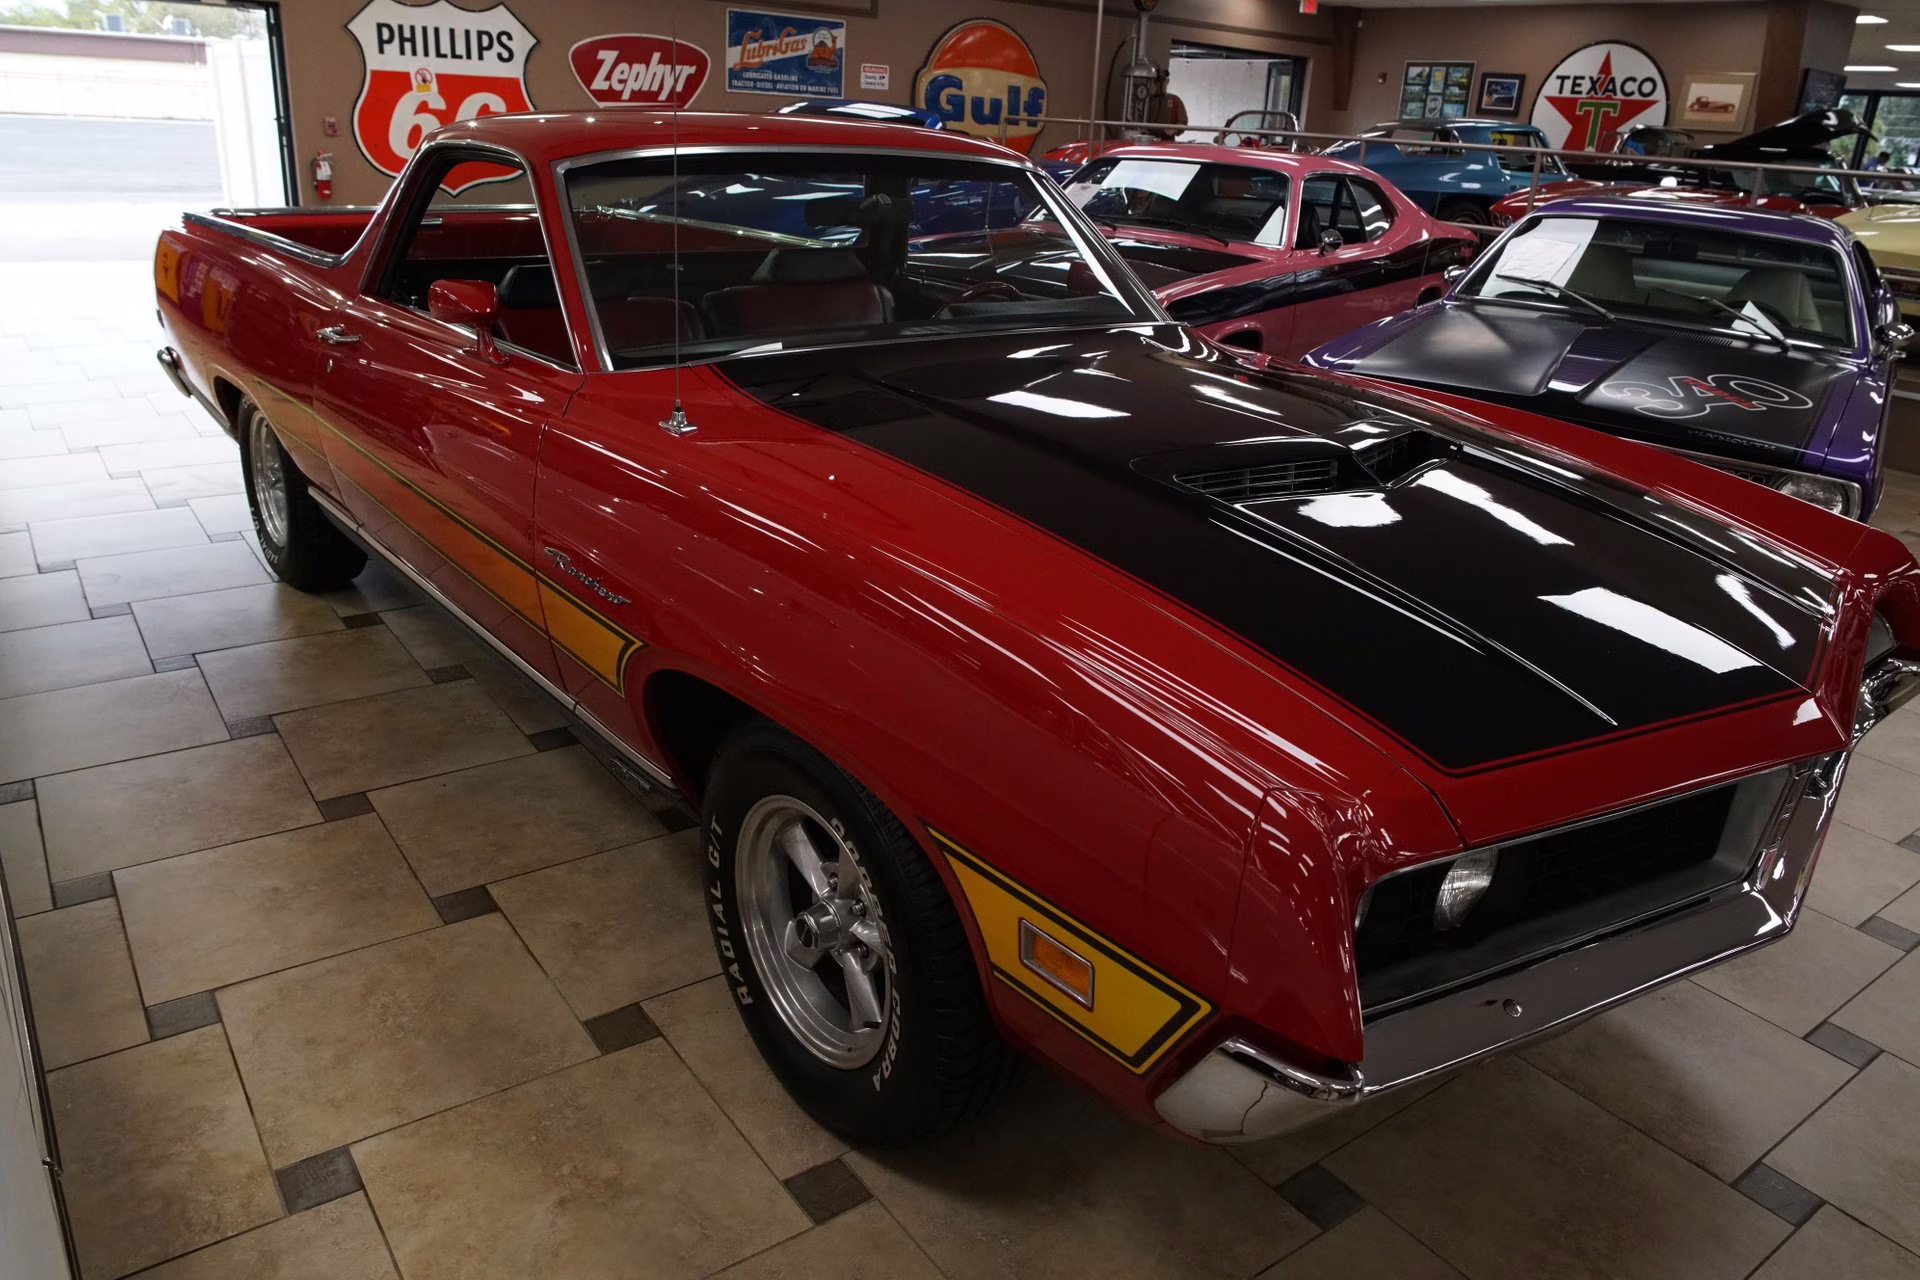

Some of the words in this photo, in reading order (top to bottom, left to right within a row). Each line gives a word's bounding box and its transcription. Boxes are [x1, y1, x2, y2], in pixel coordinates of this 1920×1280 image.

[376, 22, 515, 63] PHILLIPS
[590, 50, 697, 101] Zephyr
[925, 74, 1045, 127] Gulf
[1556, 75, 1657, 98] TEXACO
[1600, 374, 1813, 419] 340
[543, 546, 632, 605] Ranchero
[708, 815, 723, 869] G/T
[710, 880, 754, 1005] RADIAL
[872, 986, 900, 1093] COBRA
